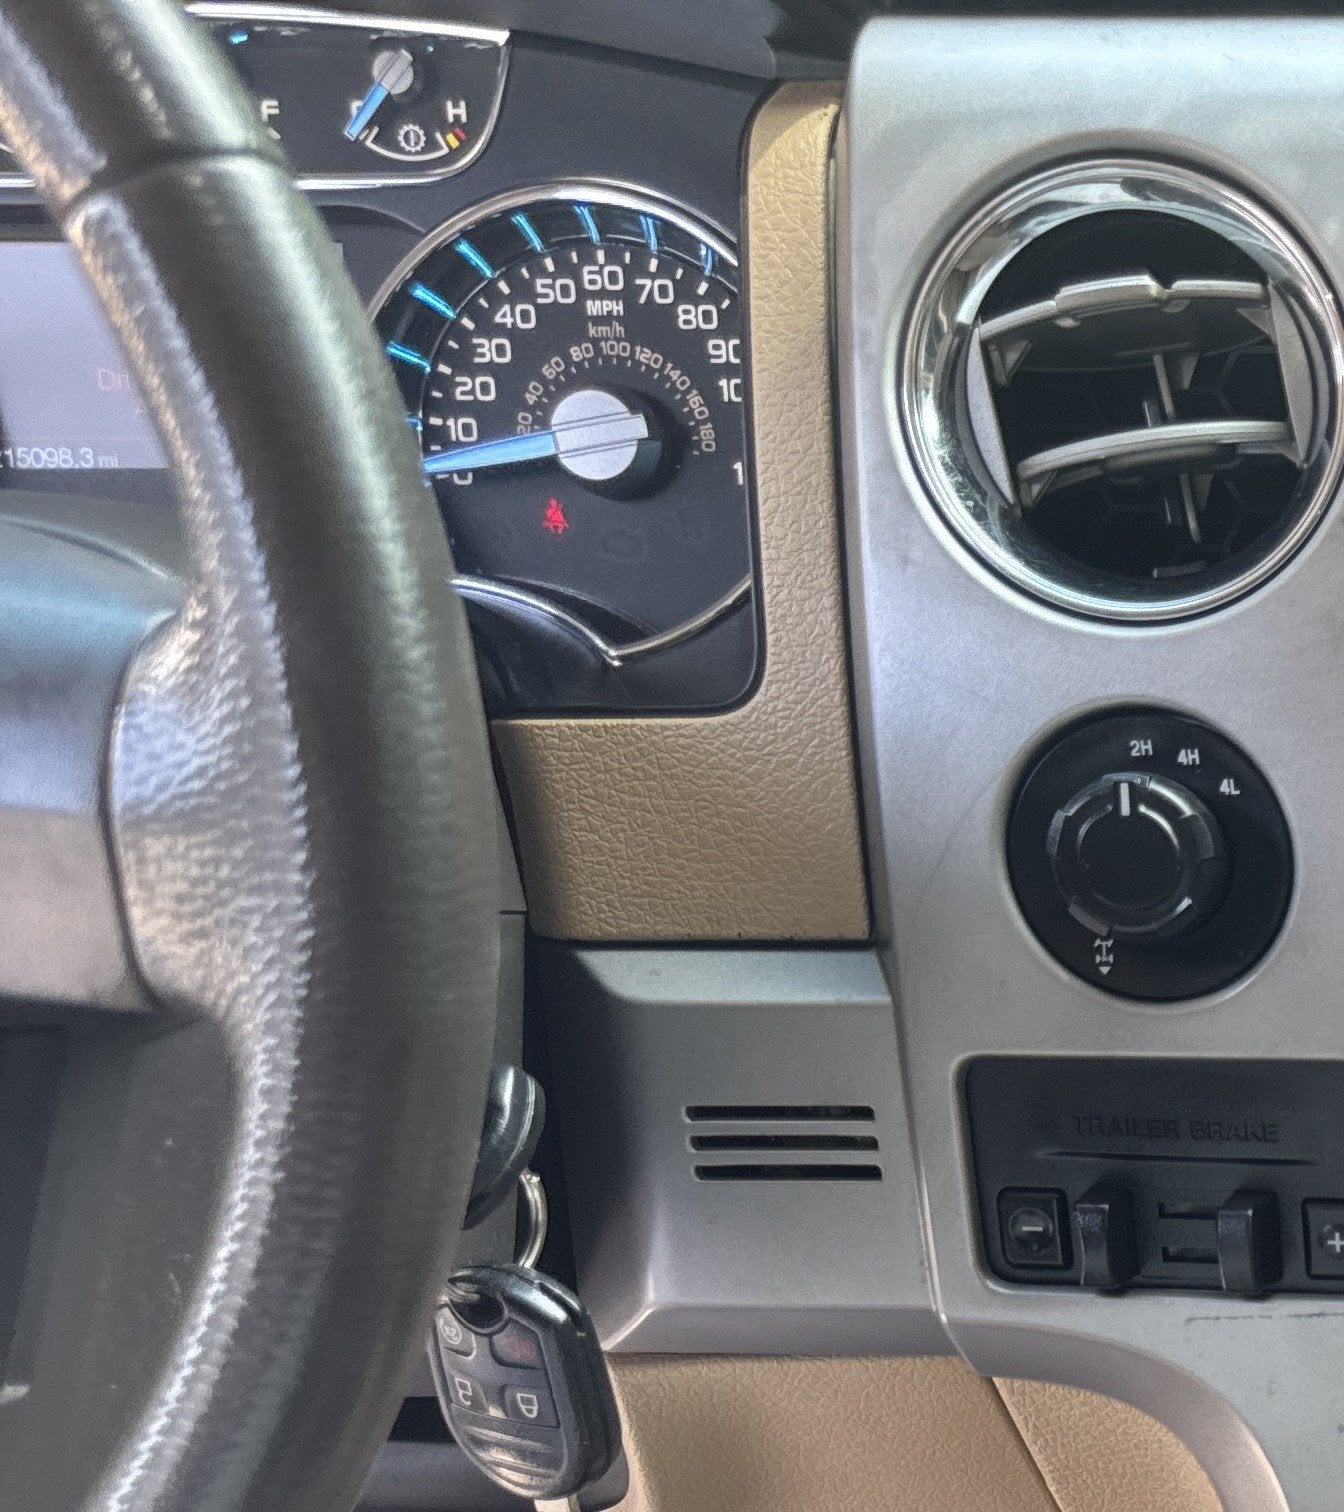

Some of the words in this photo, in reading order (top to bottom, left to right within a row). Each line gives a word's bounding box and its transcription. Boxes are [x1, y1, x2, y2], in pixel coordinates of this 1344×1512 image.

[446, 100, 467, 123] H
[583, 266, 624, 290] 60
[535, 279, 576, 304] 50
[635, 279, 674, 305] 70
[494, 303, 536, 329] 40
[586, 300, 625, 316] MPH
[677, 305, 718, 330] 80
[588, 322, 625, 339] km/h
[472, 339, 511, 364] 30
[600, 341, 630, 357] 100
[454, 376, 497, 401] 20
[445, 417, 478, 442] 10
[0, 447, 94, 469] 15098.3
[1129, 739, 1153, 758] 2H
[1177, 748, 1201, 766] 4H
[1219, 778, 1241, 797] 4L
[1071, 1114, 1181, 1140] TRAILER
[1189, 1116, 1280, 1143] BRAKE
